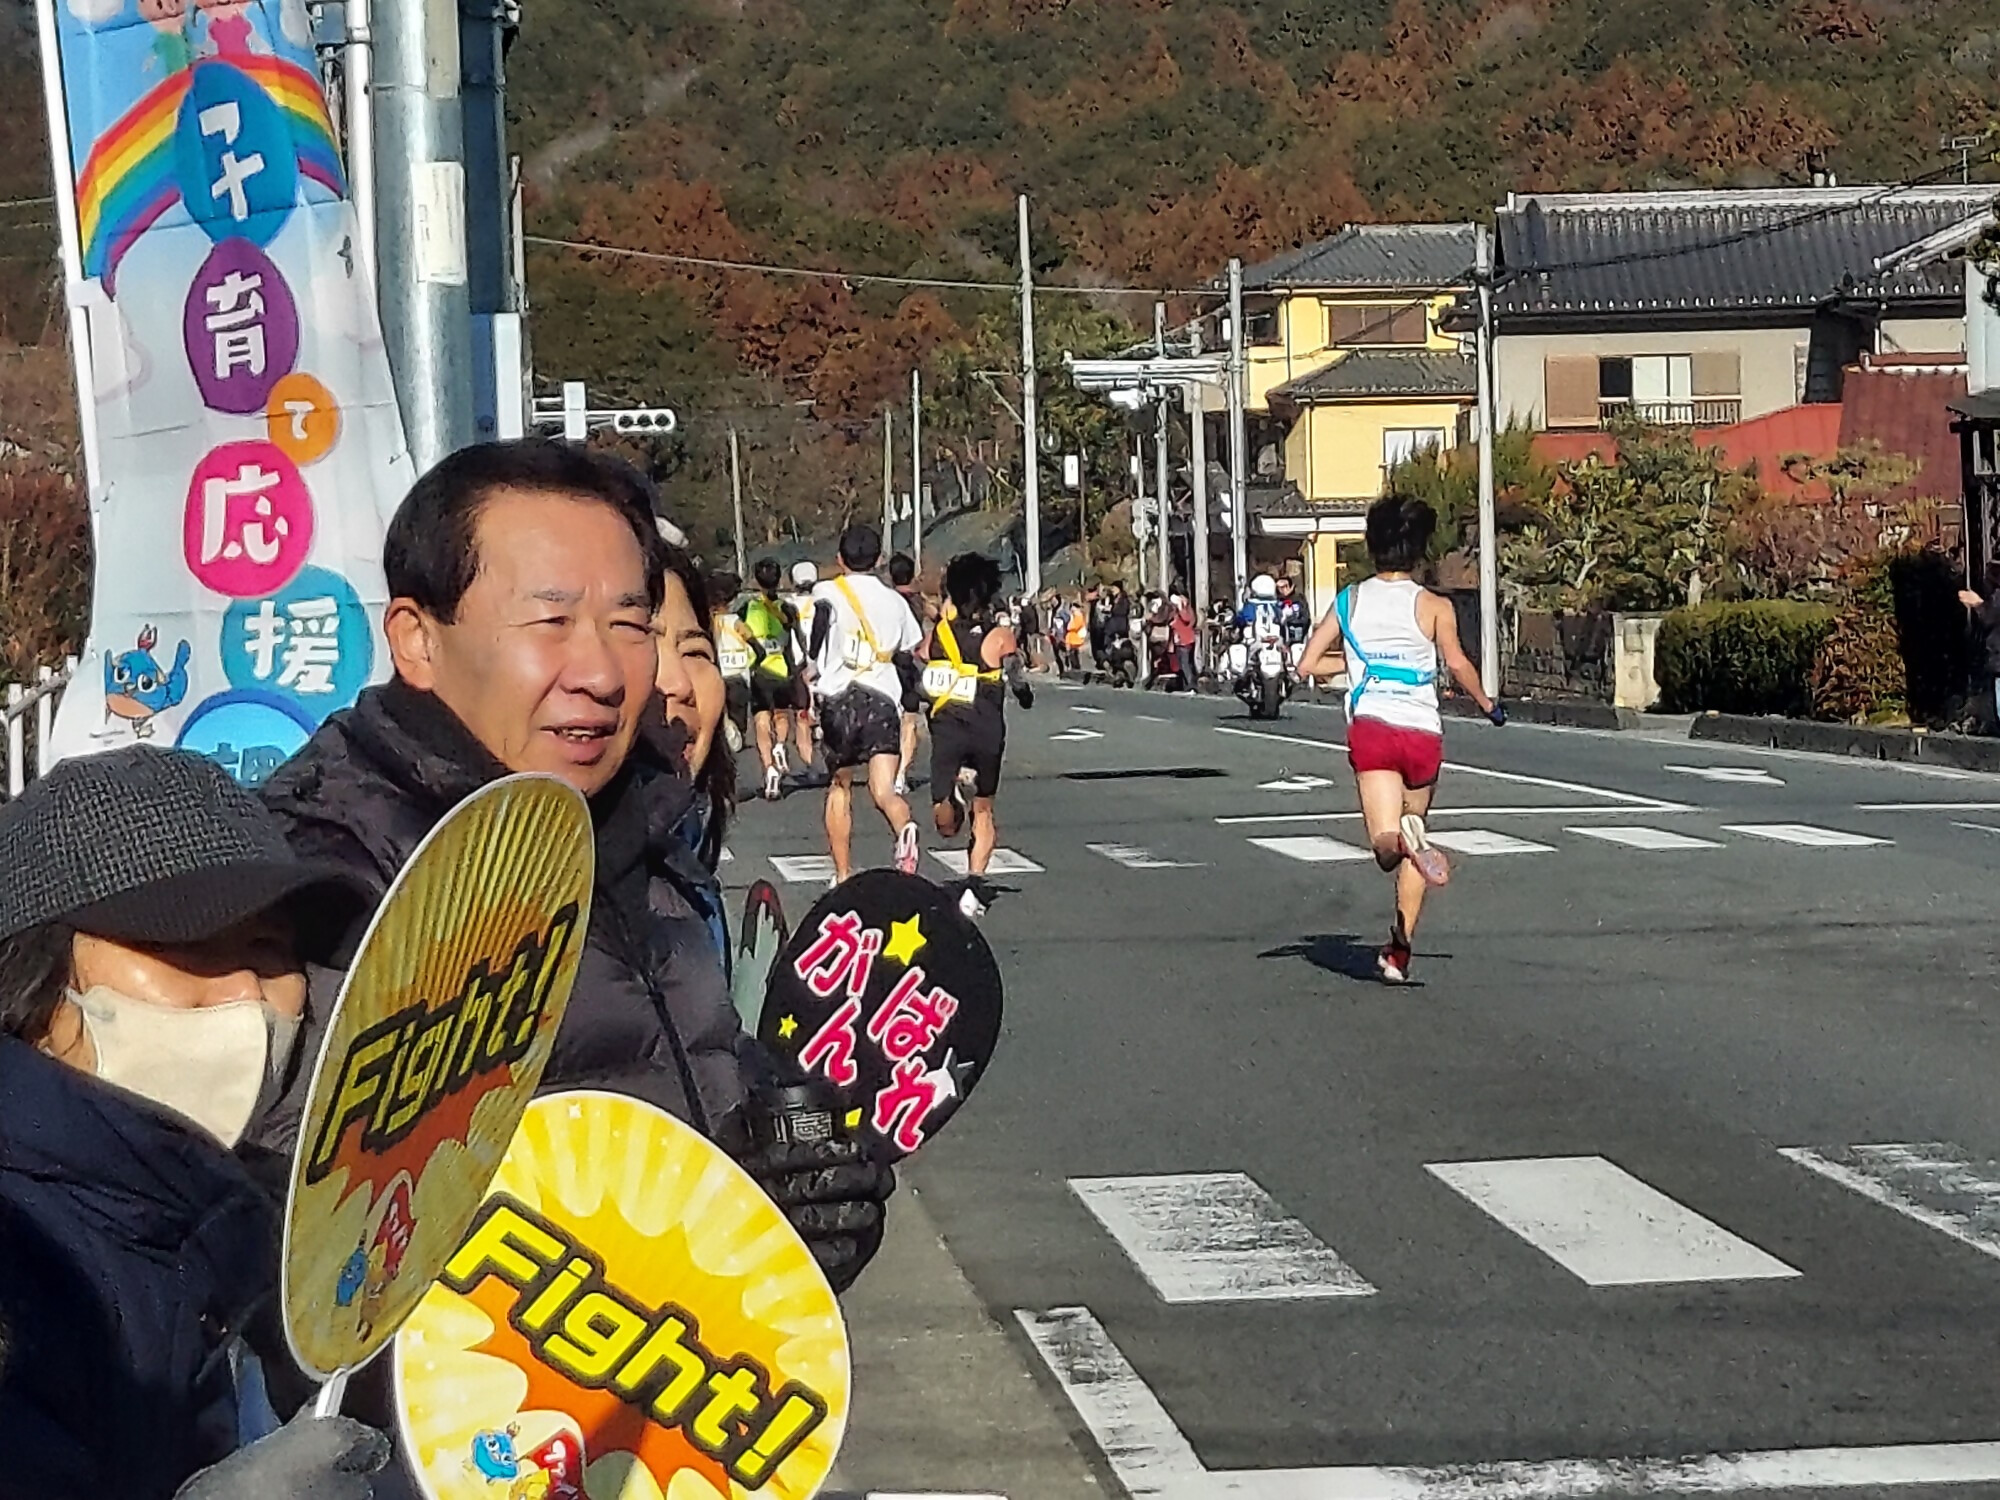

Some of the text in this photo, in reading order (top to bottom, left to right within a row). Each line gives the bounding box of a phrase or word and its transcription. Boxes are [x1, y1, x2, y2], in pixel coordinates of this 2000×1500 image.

[309, 903, 577, 1182] Fight!
[794, 910, 883, 1087] がん
[867, 965, 958, 1153] ばれ
[442, 1193, 825, 1487] Fight!
